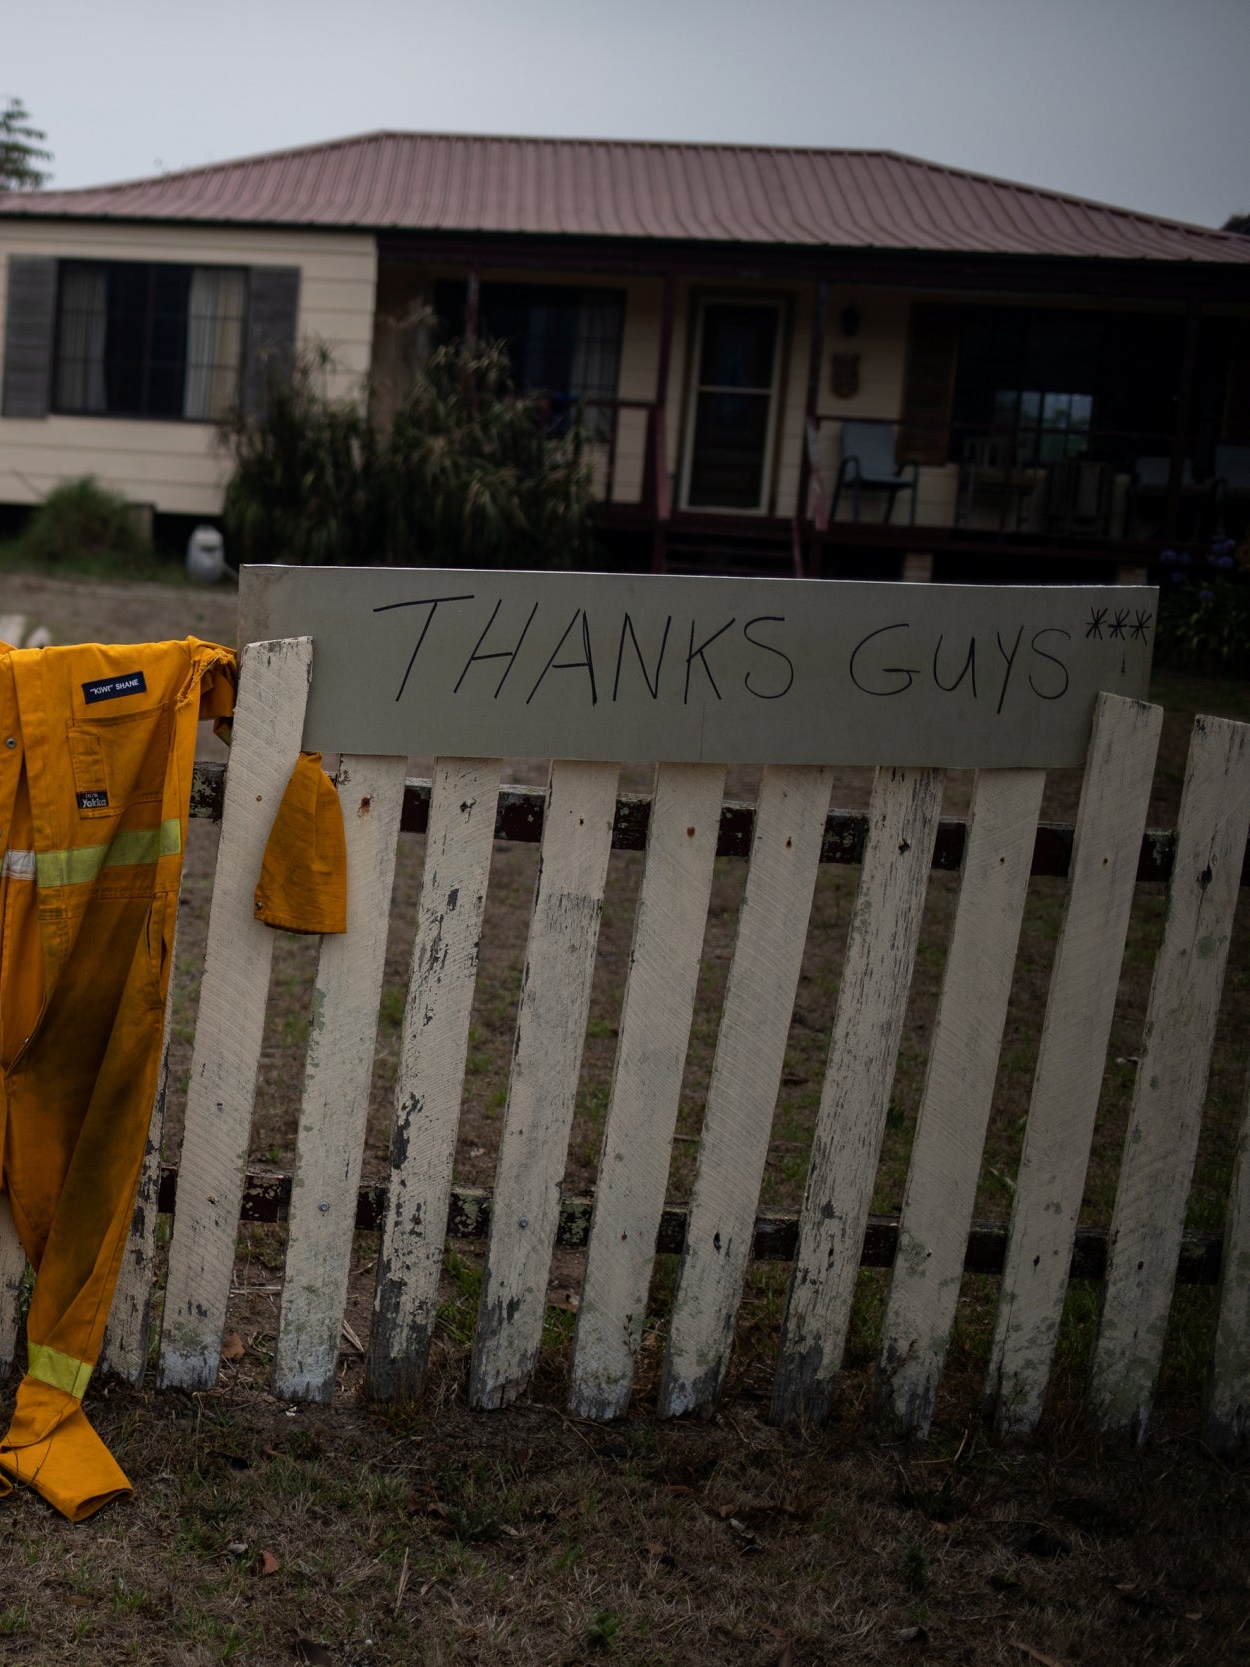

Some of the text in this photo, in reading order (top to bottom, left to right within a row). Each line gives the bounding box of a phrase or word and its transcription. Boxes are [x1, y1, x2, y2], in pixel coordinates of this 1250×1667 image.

[114, 678, 139, 690] SHANE
[373, 595, 1071, 713] THANKS GUYS
